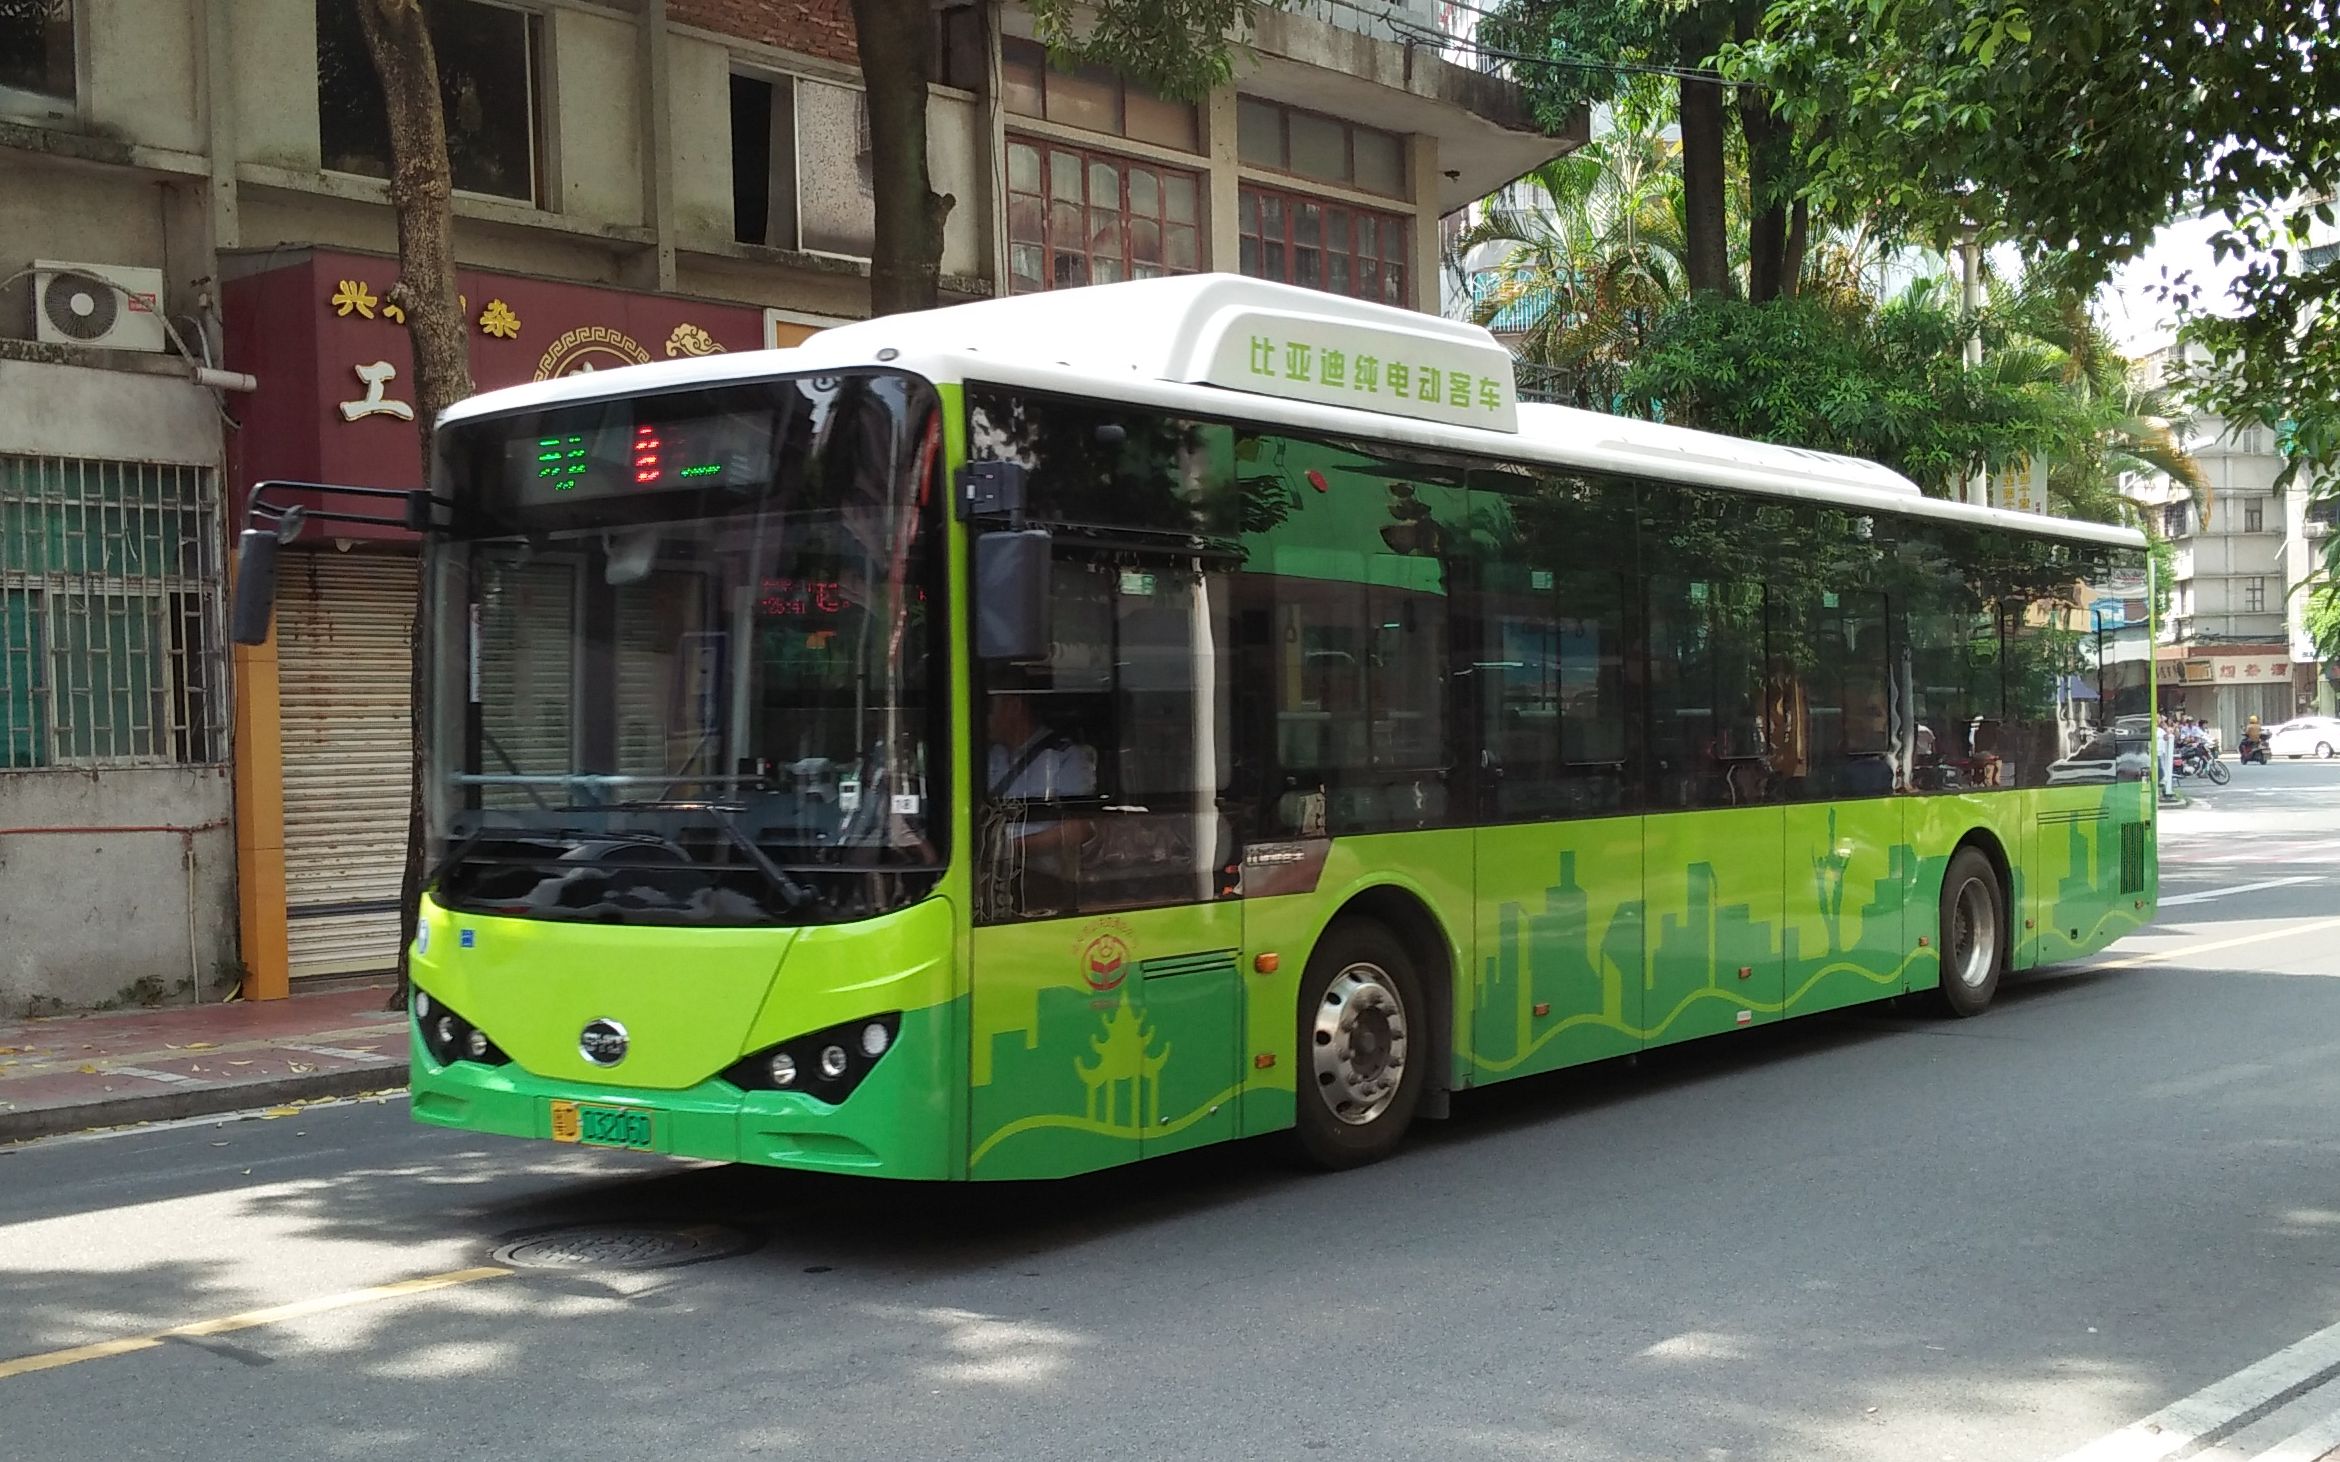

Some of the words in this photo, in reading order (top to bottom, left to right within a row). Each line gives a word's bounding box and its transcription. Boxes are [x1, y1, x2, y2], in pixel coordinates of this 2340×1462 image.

[1249, 334, 1502, 412] 比亚迪纯电动客车
